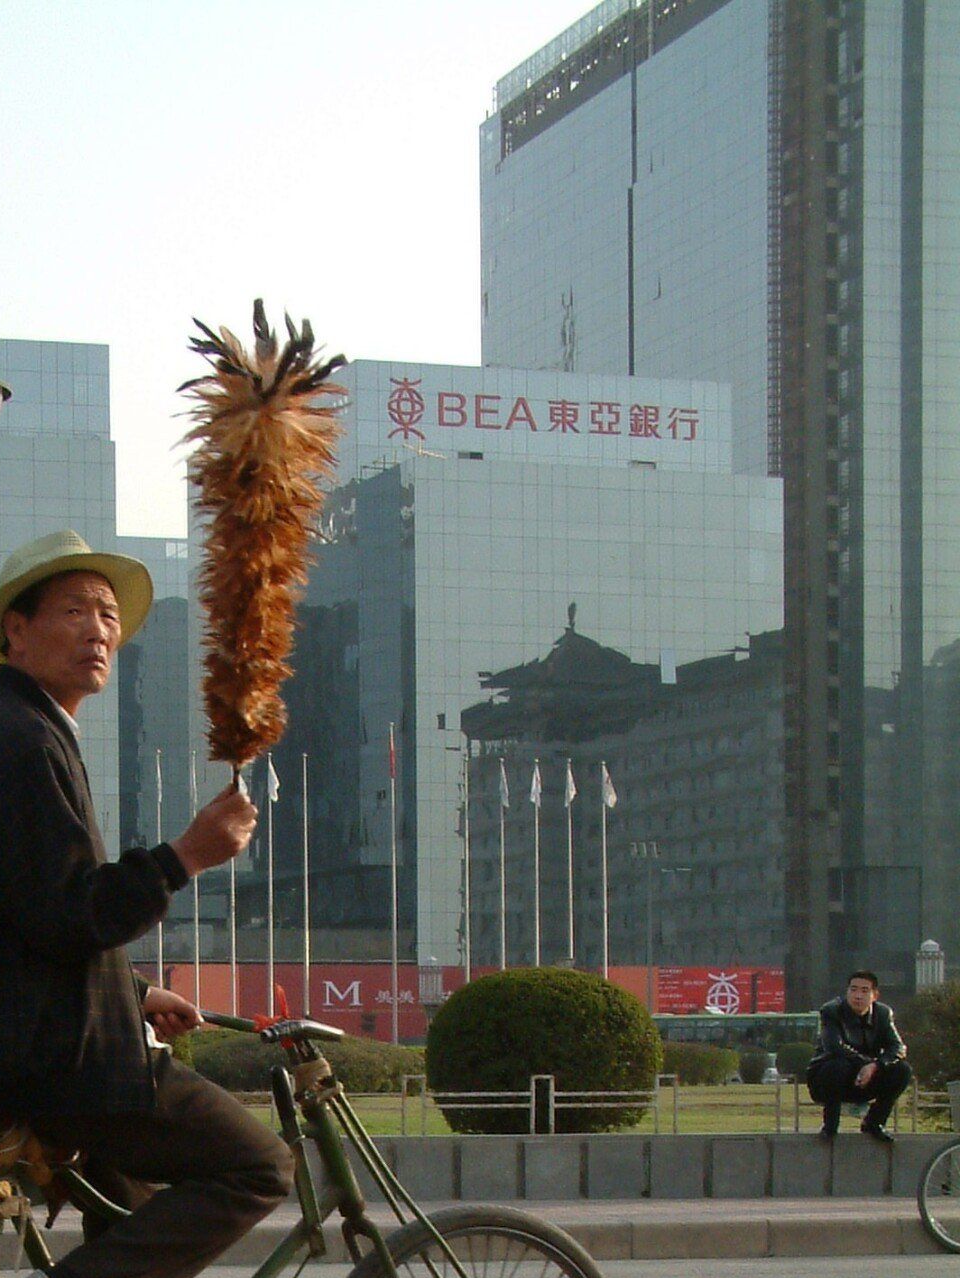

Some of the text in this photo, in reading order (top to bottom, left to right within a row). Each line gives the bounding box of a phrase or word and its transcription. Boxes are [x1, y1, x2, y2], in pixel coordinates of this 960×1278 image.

[437, 391, 700, 441] BEA 東亞銀行
[322, 980, 363, 1006] M
